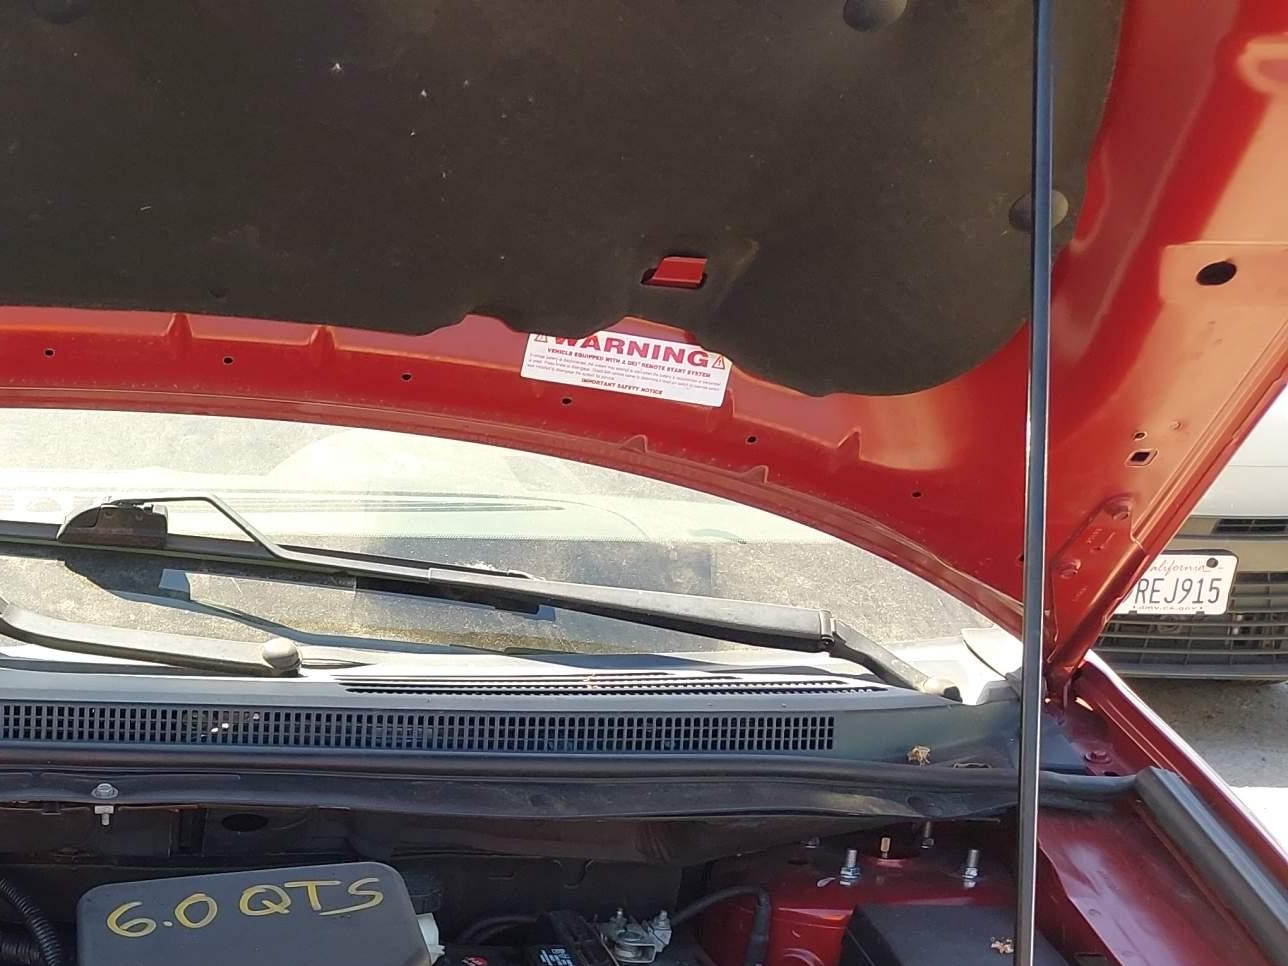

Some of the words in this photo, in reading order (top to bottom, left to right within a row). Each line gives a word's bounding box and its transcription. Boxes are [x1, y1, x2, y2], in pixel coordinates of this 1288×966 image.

[547, 347, 572, 356] VEHICLE
[574, 352, 604, 361] EQUIPPED
[641, 362, 665, 371] REMOTE
[555, 335, 709, 367] WARNING
[581, 378, 616, 388] IMPORTANT
[617, 383, 640, 391] SAFETY
[641, 387, 663, 395] NOTICE
[1149, 559, 1206, 576] alifornia
[1122, 577, 1222, 604] REJ915
[106, 893, 218, 938] 6.0
[239, 877, 384, 917] QTS
